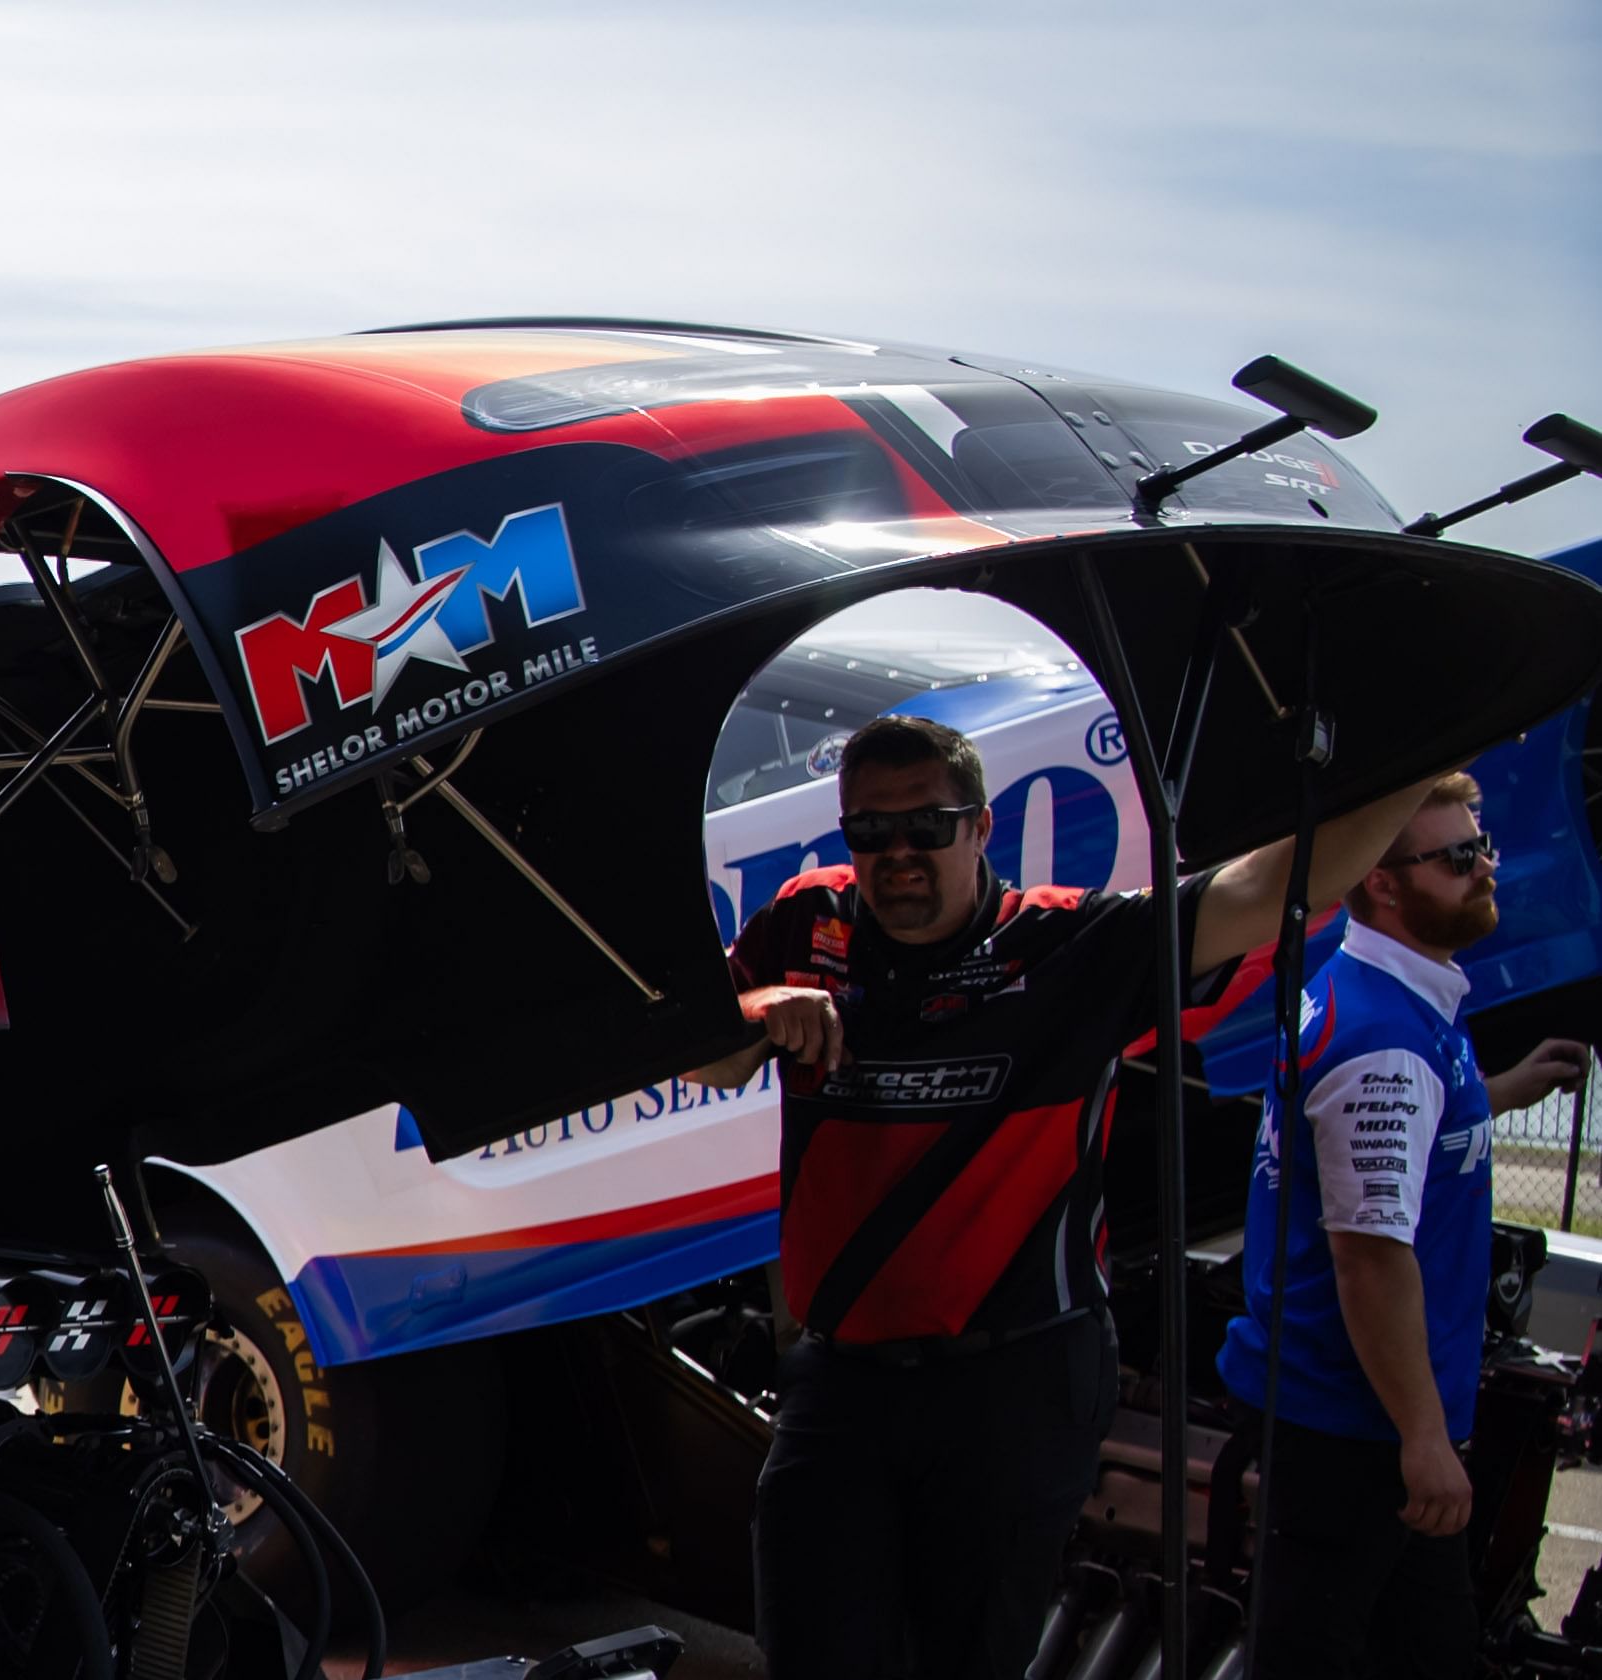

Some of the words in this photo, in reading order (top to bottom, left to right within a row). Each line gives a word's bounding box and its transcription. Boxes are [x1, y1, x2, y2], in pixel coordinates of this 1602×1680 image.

[1182, 441, 1326, 475] DODGE
[1264, 473, 1331, 495] SRT
[275, 725, 386, 794] SHELOR
[395, 671, 513, 739] MOTOR
[522, 637, 598, 686] MILE
[255, 1286, 336, 1457] EAGLE
